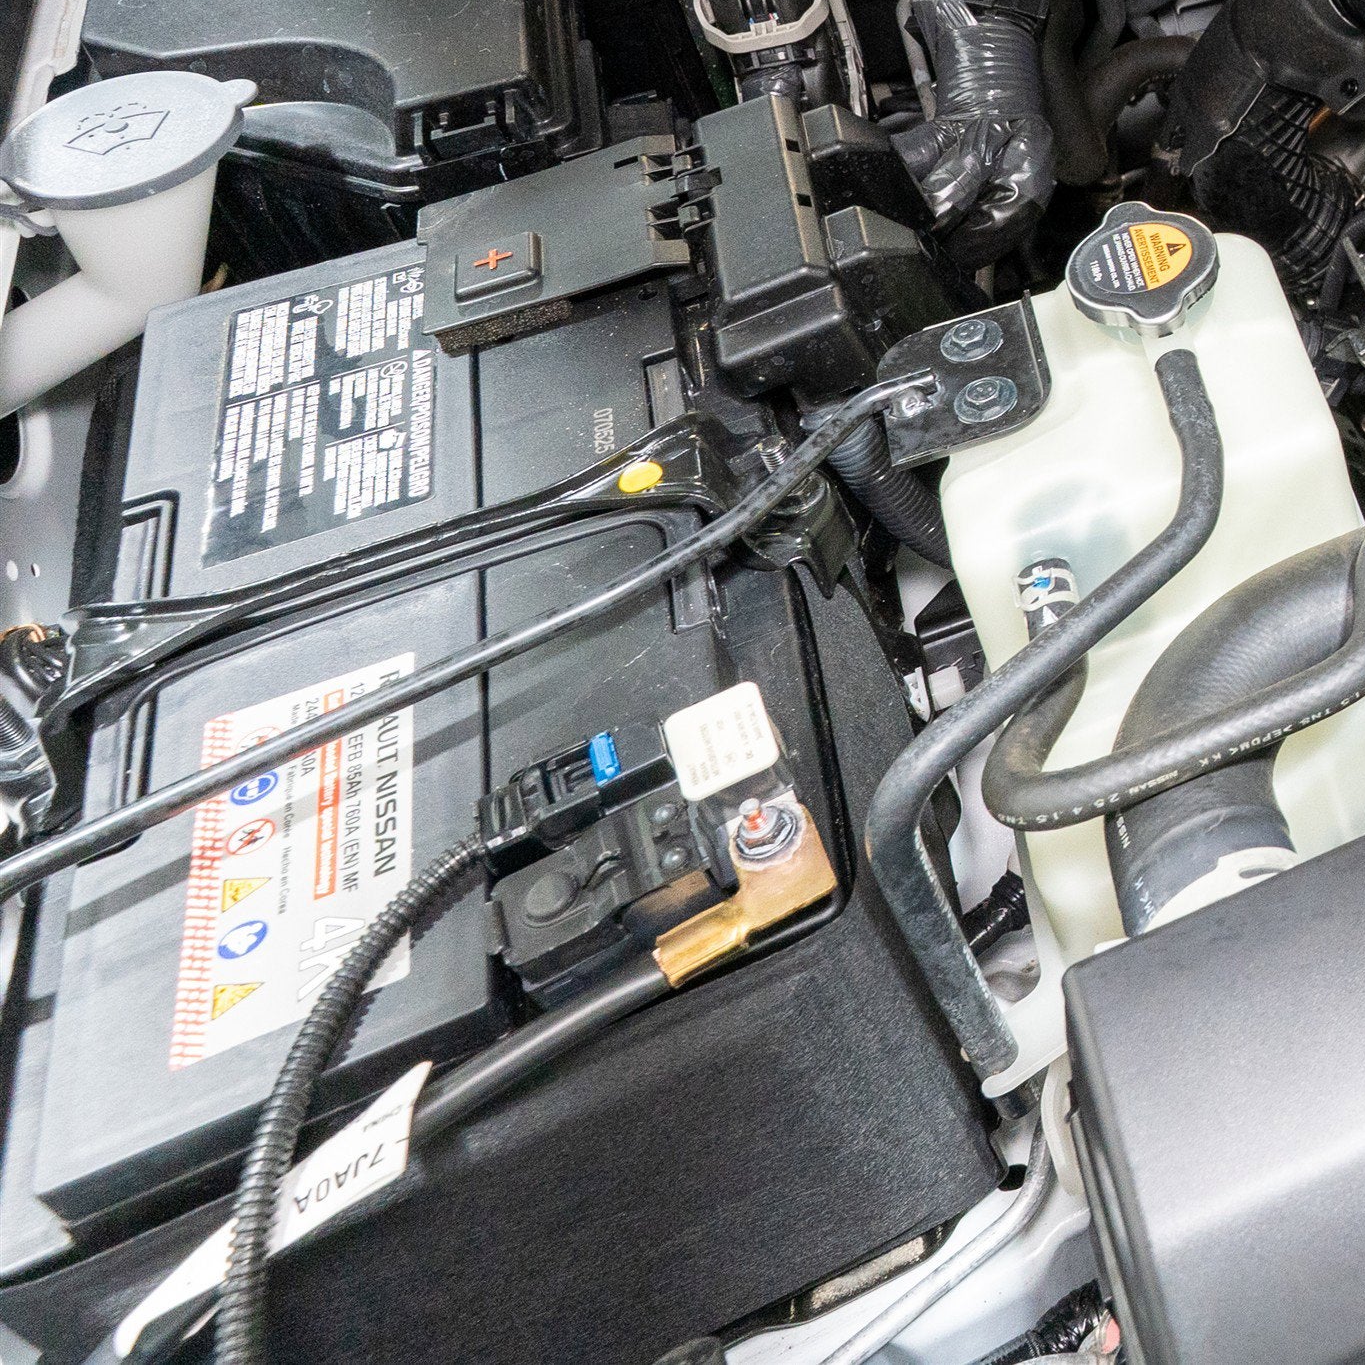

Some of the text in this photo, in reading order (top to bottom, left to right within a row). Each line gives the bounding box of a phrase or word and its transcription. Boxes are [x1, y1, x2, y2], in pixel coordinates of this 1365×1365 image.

[1134, 229, 1160, 283] AVERTISSEMENT
[1149, 232, 1171, 272] WARNING
[593, 408, 615, 454] 070525
[348, 733, 364, 762] EFB
[346, 763, 362, 800] 85Ah
[1128, 770, 1179, 795] NISSAN
[345, 800, 361, 837] 760A
[373, 770, 398, 877] NISSAN
[340, 838, 360, 871] (EN)
[342, 871, 359, 893] MF
